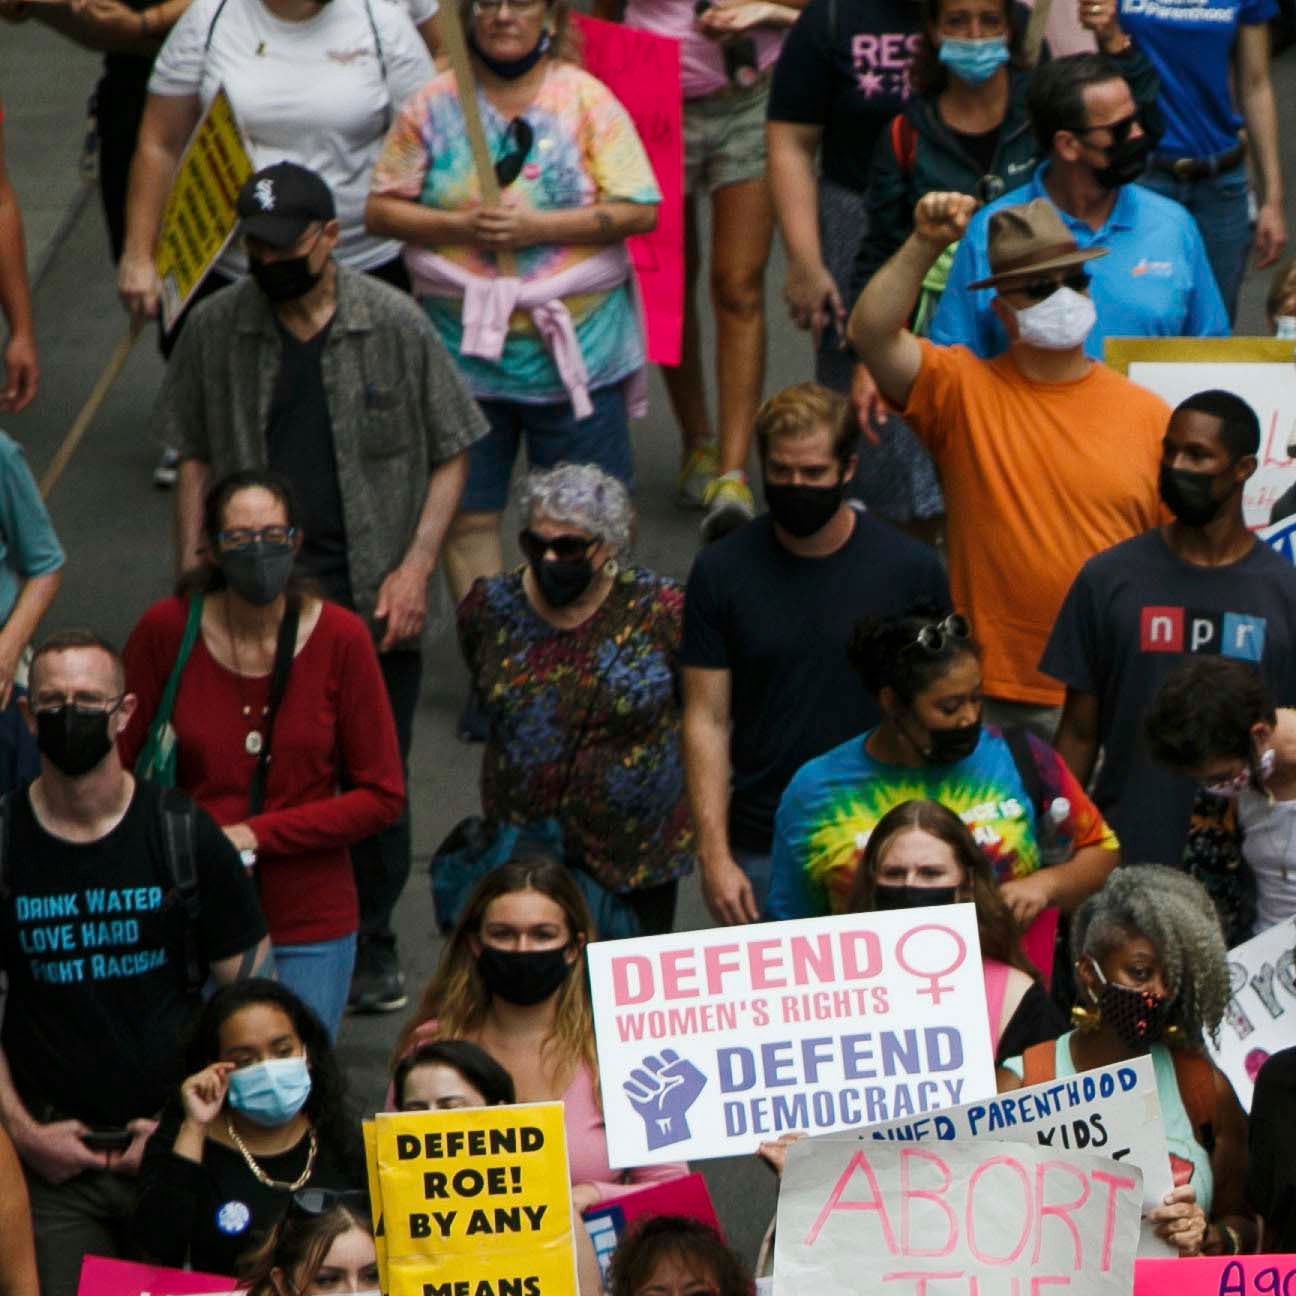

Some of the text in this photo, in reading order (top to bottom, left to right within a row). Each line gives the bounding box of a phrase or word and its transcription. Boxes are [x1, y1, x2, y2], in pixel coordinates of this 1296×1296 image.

[20, 918, 139, 953] LOVE HARD
[611, 928, 884, 1008] DEFEND
[616, 986, 889, 1043] WOMEN'S RIGHTS
[716, 1025, 966, 1094] DEFEND
[396, 1126, 545, 1161] DEFEND
[423, 1166, 523, 1200] ROE!
[409, 1205, 547, 1239] BY ANY
